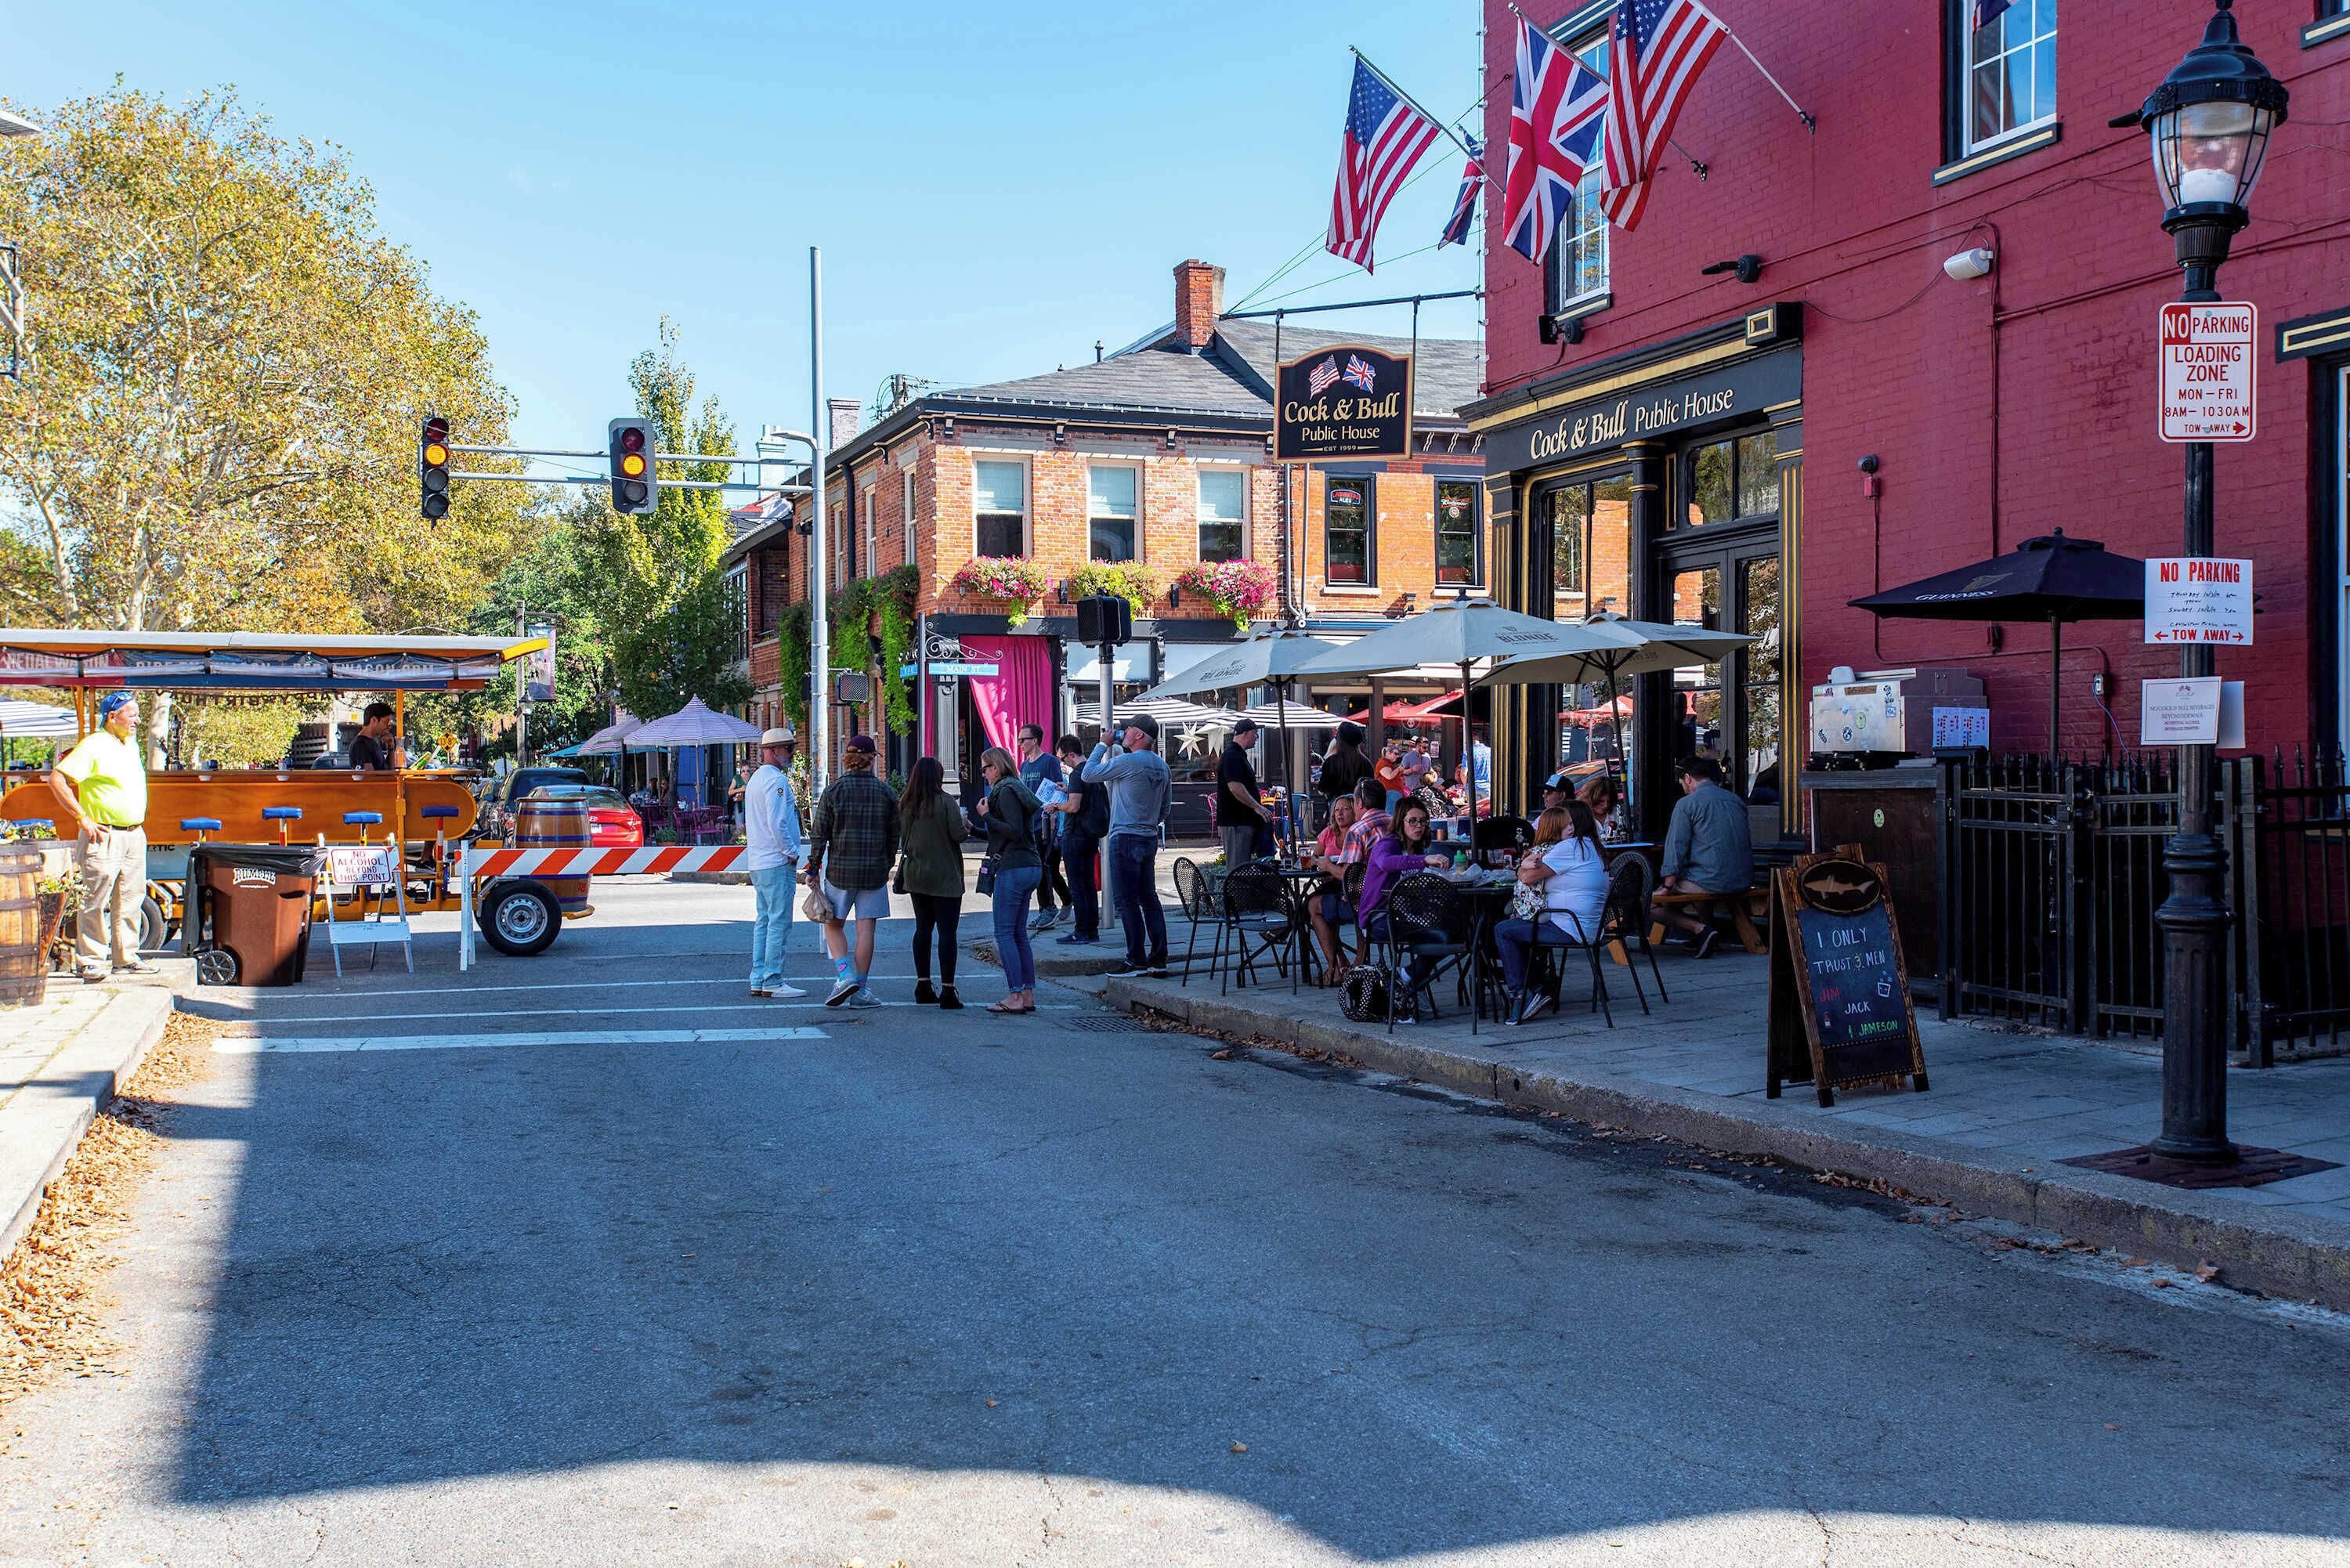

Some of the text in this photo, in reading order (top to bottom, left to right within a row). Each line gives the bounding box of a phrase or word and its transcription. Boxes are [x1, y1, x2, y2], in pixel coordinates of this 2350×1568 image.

[2164, 313, 2249, 338] NO PARKING
[2175, 346, 2241, 363] LOADING
[2186, 365, 2229, 381] ZONE
[2178, 388, 2203, 400] MON
[2218, 388, 2238, 399] FRI
[1284, 392, 1400, 423] Cock & Bull
[1530, 388, 1734, 460] Cock & Bull Public House
[1302, 425, 1380, 441] Public House
[2160, 562, 2240, 583] NO PARKING
[1914, 590, 1994, 601] GUINNESS
[2172, 630, 2231, 641] TOW AWAY
[946, 665, 967, 674] MAIN
[345, 865, 378, 874] BEYOND
[1817, 927, 1867, 948] I ONLY
[1813, 957, 1851, 974] TRUST
[1865, 949, 1886, 966] MEN
[1819, 988, 1840, 1002] JIM
[1844, 1001, 1871, 1014] JACK
[1859, 1019, 1899, 1036] JAMESON
